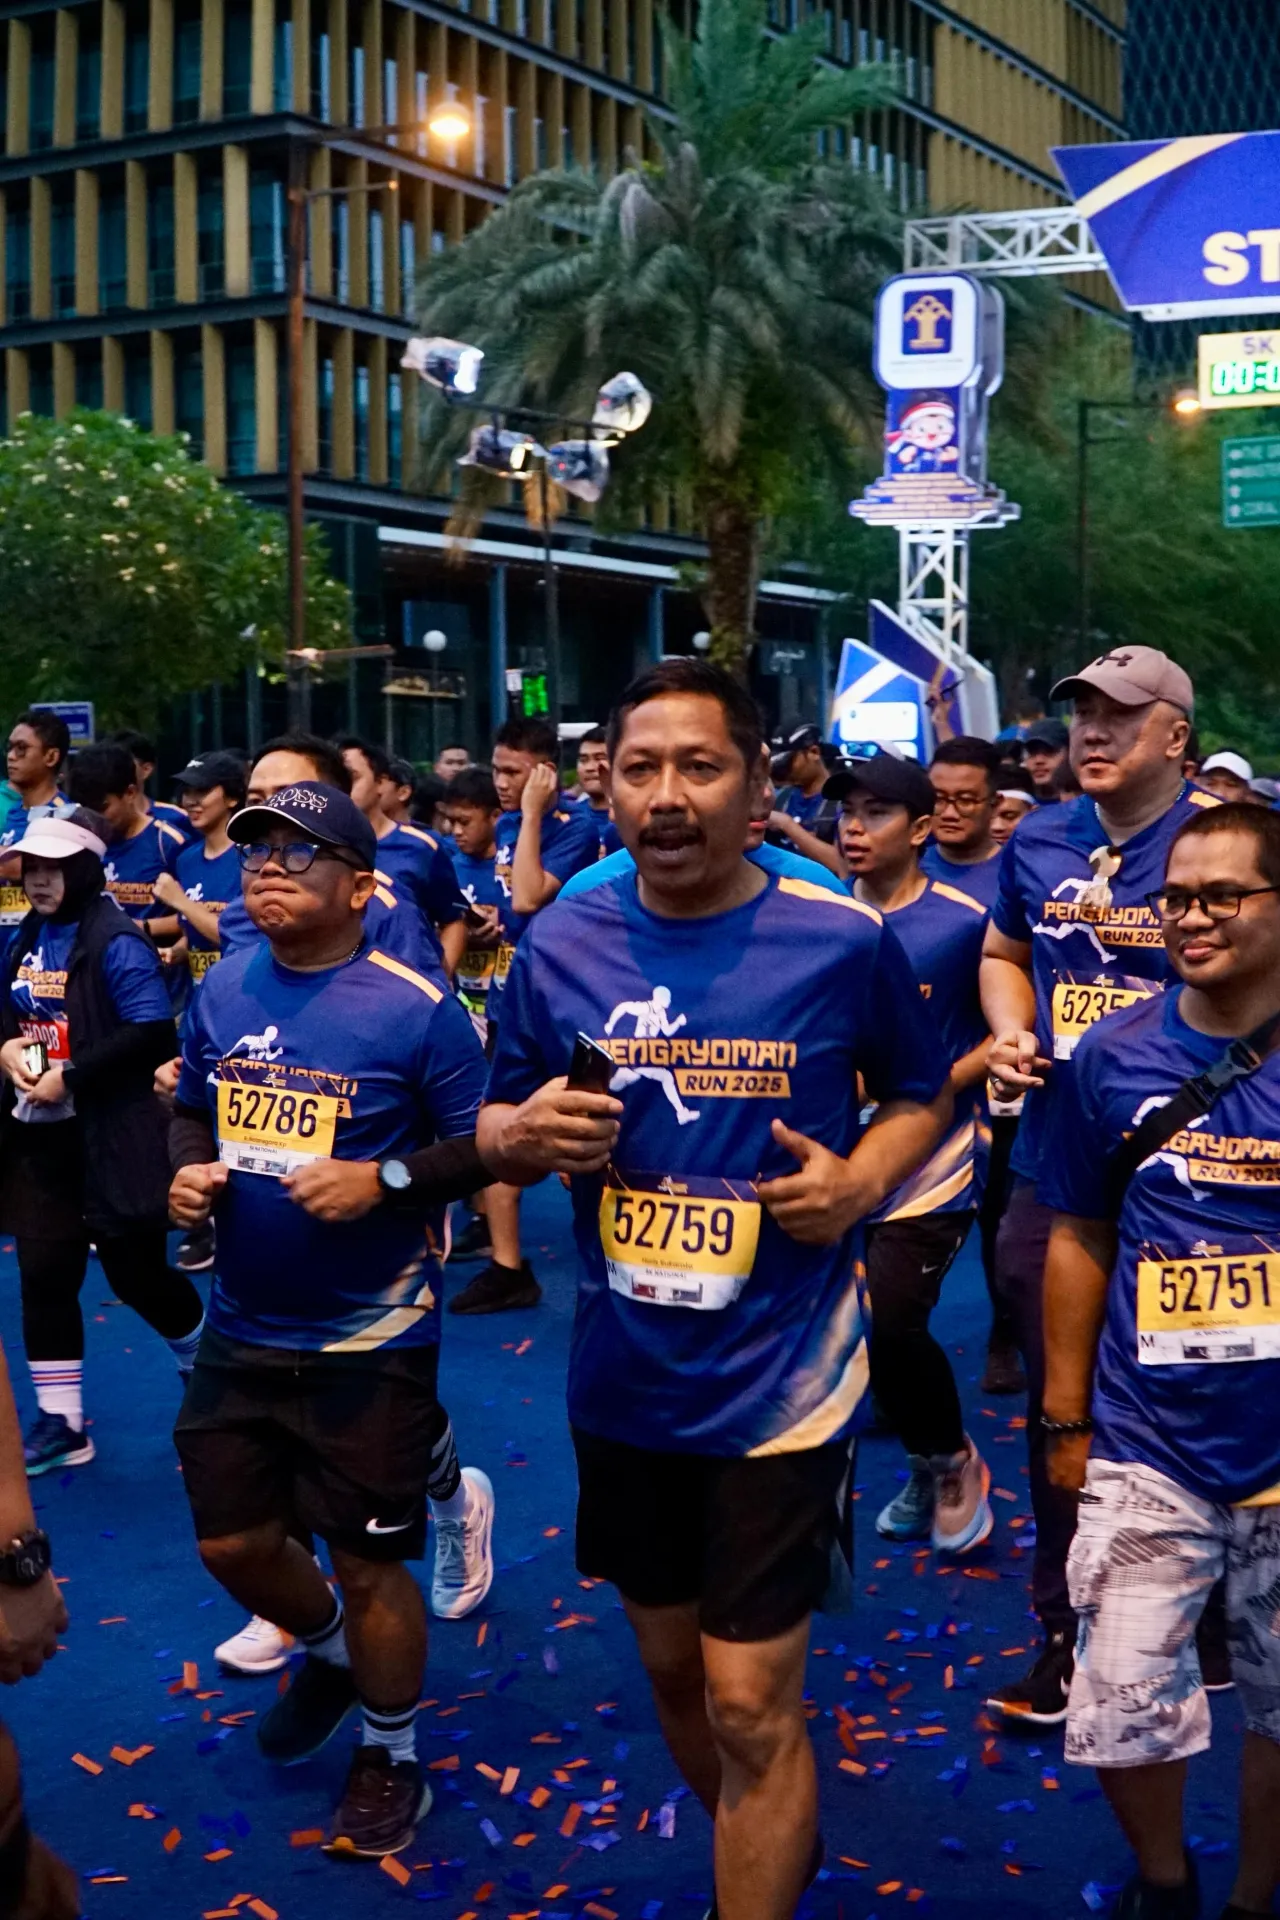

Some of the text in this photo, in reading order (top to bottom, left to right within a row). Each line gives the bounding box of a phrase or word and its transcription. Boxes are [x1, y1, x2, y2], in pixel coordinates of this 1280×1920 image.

[1243, 336, 1275, 355] 5K
[1104, 931, 1133, 942] RUN
[685, 1075, 782, 1093] RUN 2025
[227, 1087, 319, 1138] 52786
[1198, 1165, 1238, 1181] RUN
[614, 1195, 734, 1256] 52759
[1160, 1261, 1271, 1314] 52751
[1140, 1334, 1154, 1348] M
